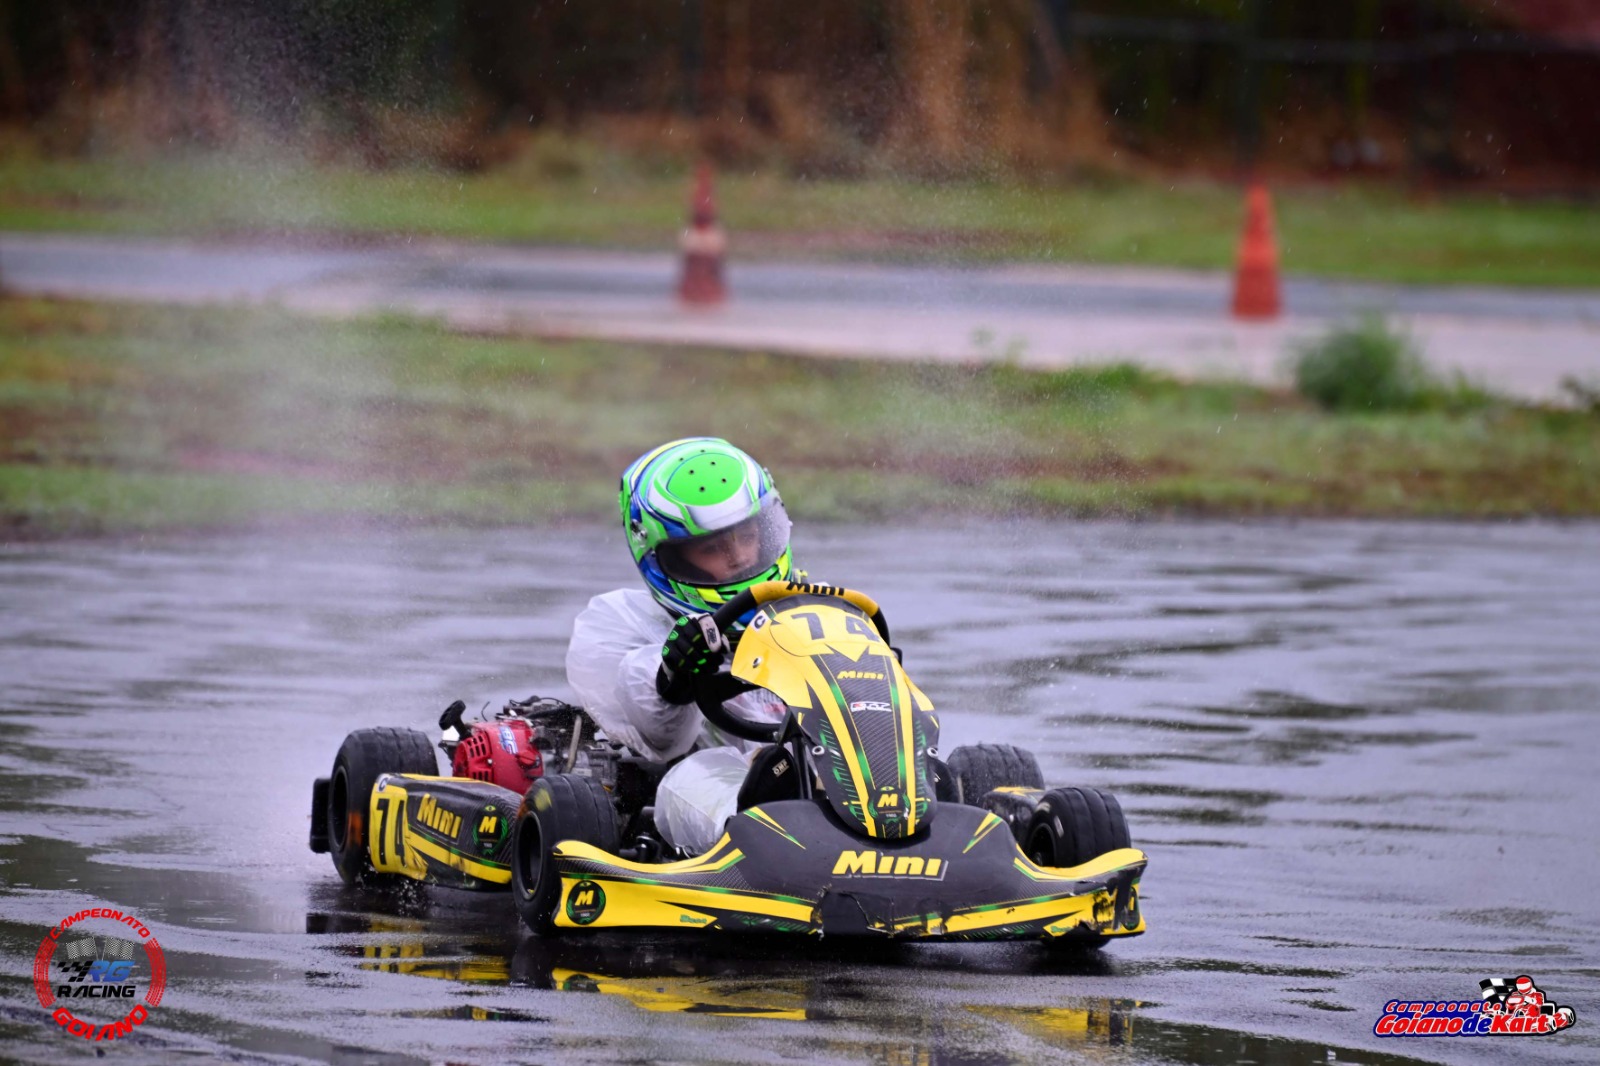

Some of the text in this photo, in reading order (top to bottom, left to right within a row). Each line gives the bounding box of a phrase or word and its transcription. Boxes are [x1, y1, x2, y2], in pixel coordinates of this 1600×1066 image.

[837, 670, 885, 680] Mini
[416, 793, 462, 839] Mini
[832, 850, 942, 876] Mini
